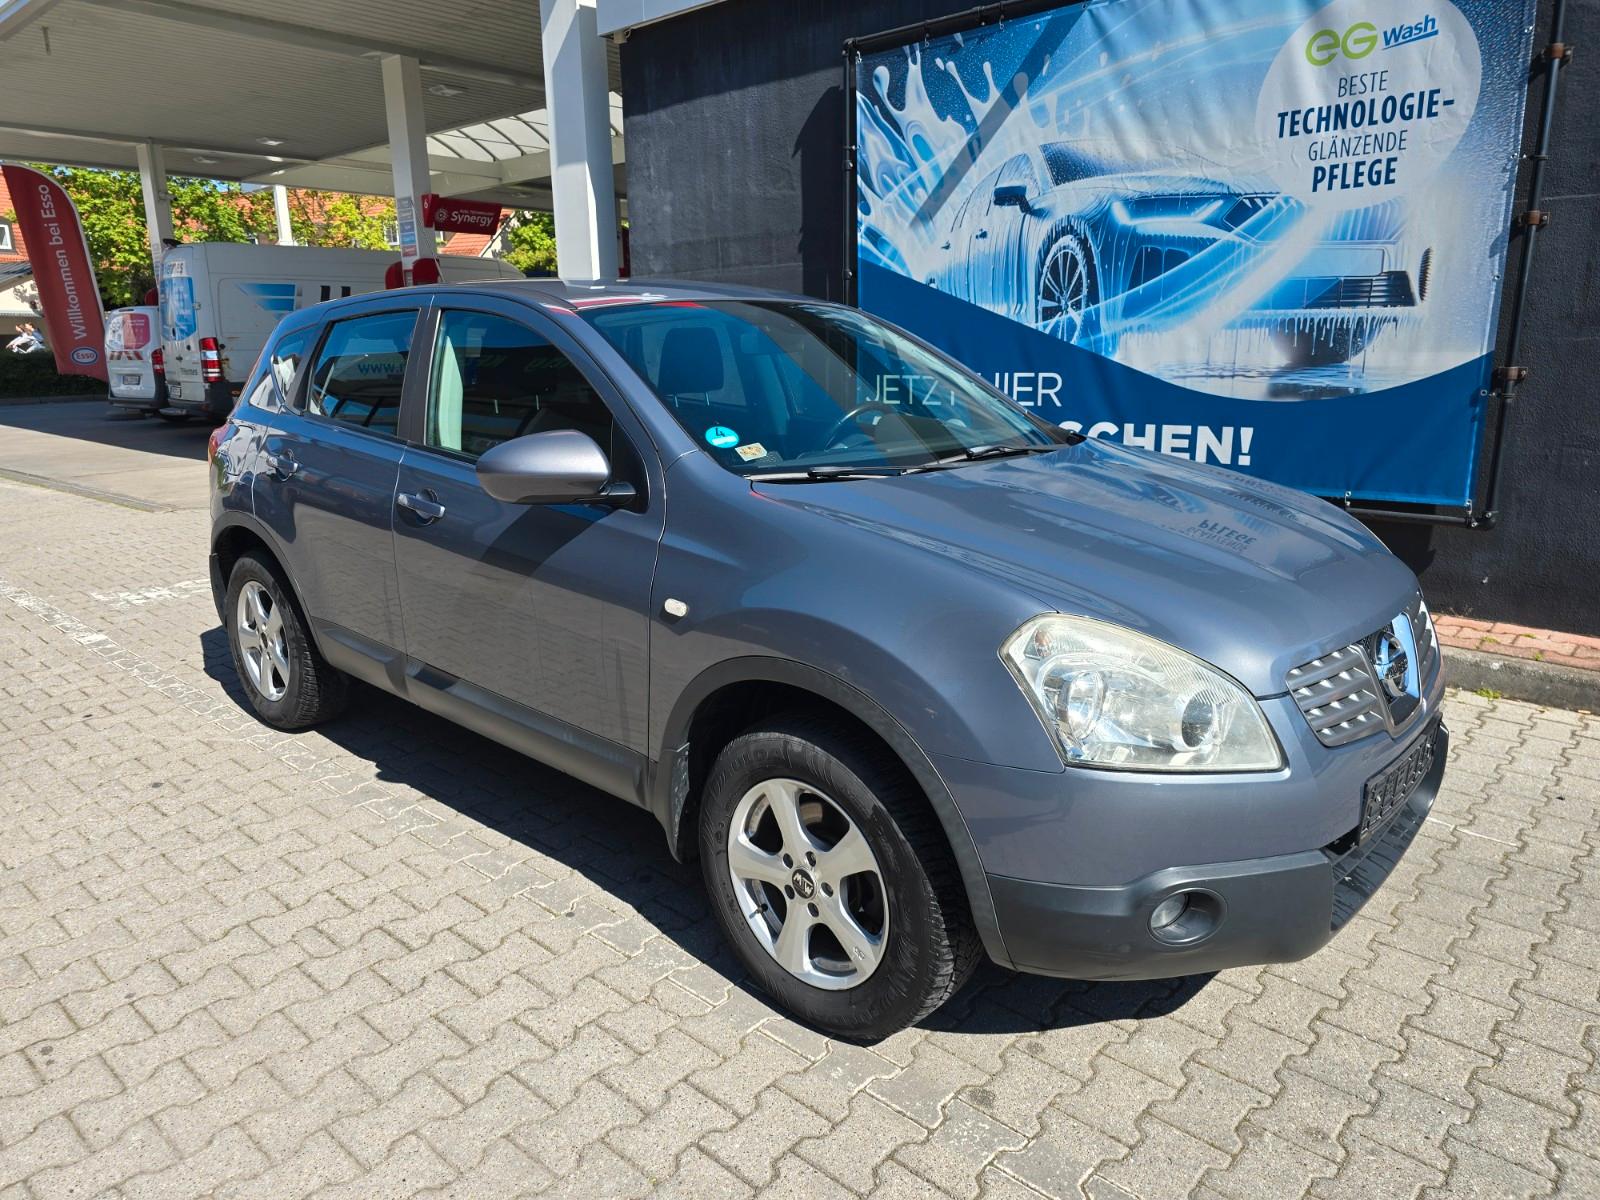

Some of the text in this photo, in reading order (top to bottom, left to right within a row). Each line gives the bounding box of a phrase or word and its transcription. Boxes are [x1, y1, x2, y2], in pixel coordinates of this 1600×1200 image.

[1383, 14, 1437, 47] Wash
[1337, 70, 1389, 97] BESTE
[1277, 88, 1455, 138] TECHNOLOGIE-
[1308, 129, 1408, 161] GLÄNZENDE
[1312, 157, 1398, 192] PFLEGE
[451, 211, 493, 226] Synergy
[38, 184, 87, 341] Willkommen bei Esso
[75, 352, 95, 360] Esso
[866, 374, 955, 406] JETZ
